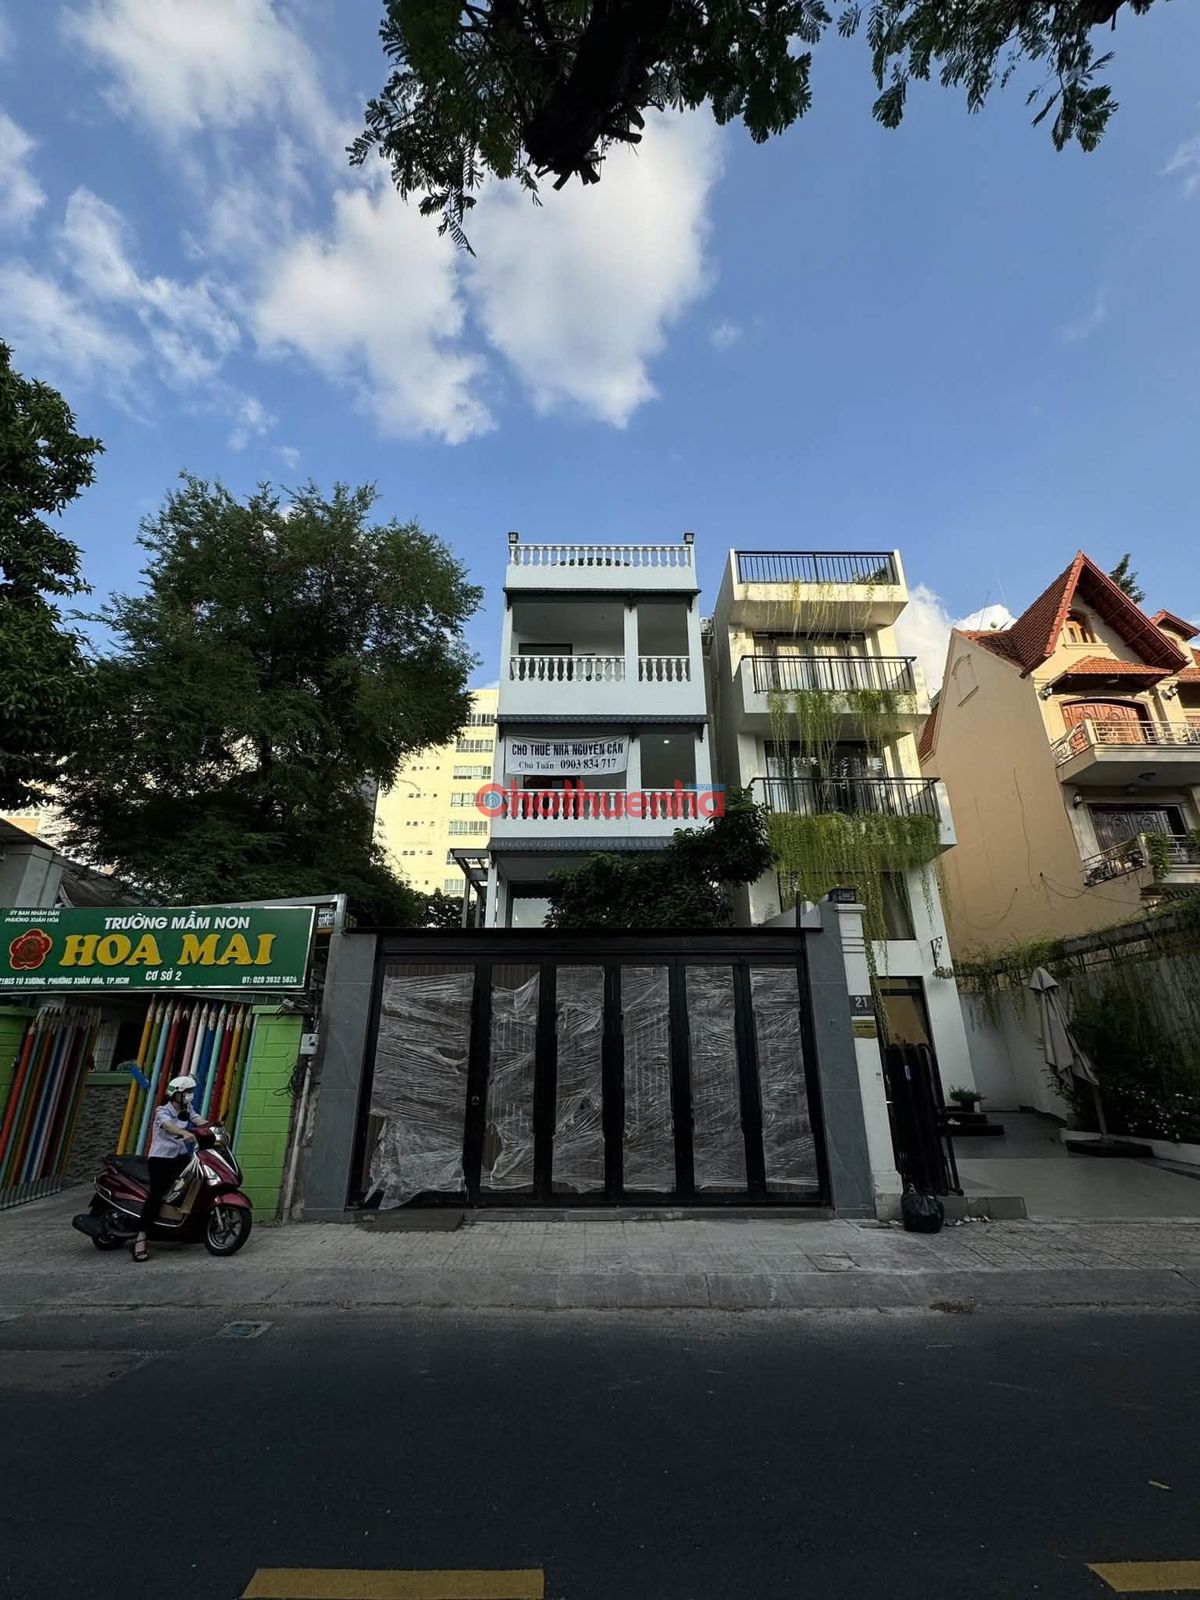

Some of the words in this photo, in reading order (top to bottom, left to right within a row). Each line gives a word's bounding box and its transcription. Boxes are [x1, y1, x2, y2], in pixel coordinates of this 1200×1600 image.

[512, 744, 527, 756] CHO
[530, 742, 551, 756] THUÊ
[572, 741, 605, 755] NGUYÊN
[560, 759, 581, 769] 0903
[583, 759, 599, 769] 834
[601, 758, 617, 769] 717
[104, 912, 168, 930] TRƯỜNG
[171, 911, 210, 930] MẦM
[214, 916, 250, 929] NON
[59, 934, 164, 966] HOA
[176, 933, 276, 966] MAI
[145, 970, 158, 981] CƠ
[160, 967, 174, 981] SỞ
[174, 971, 182, 981] 2
[855, 996, 868, 1008] 21
